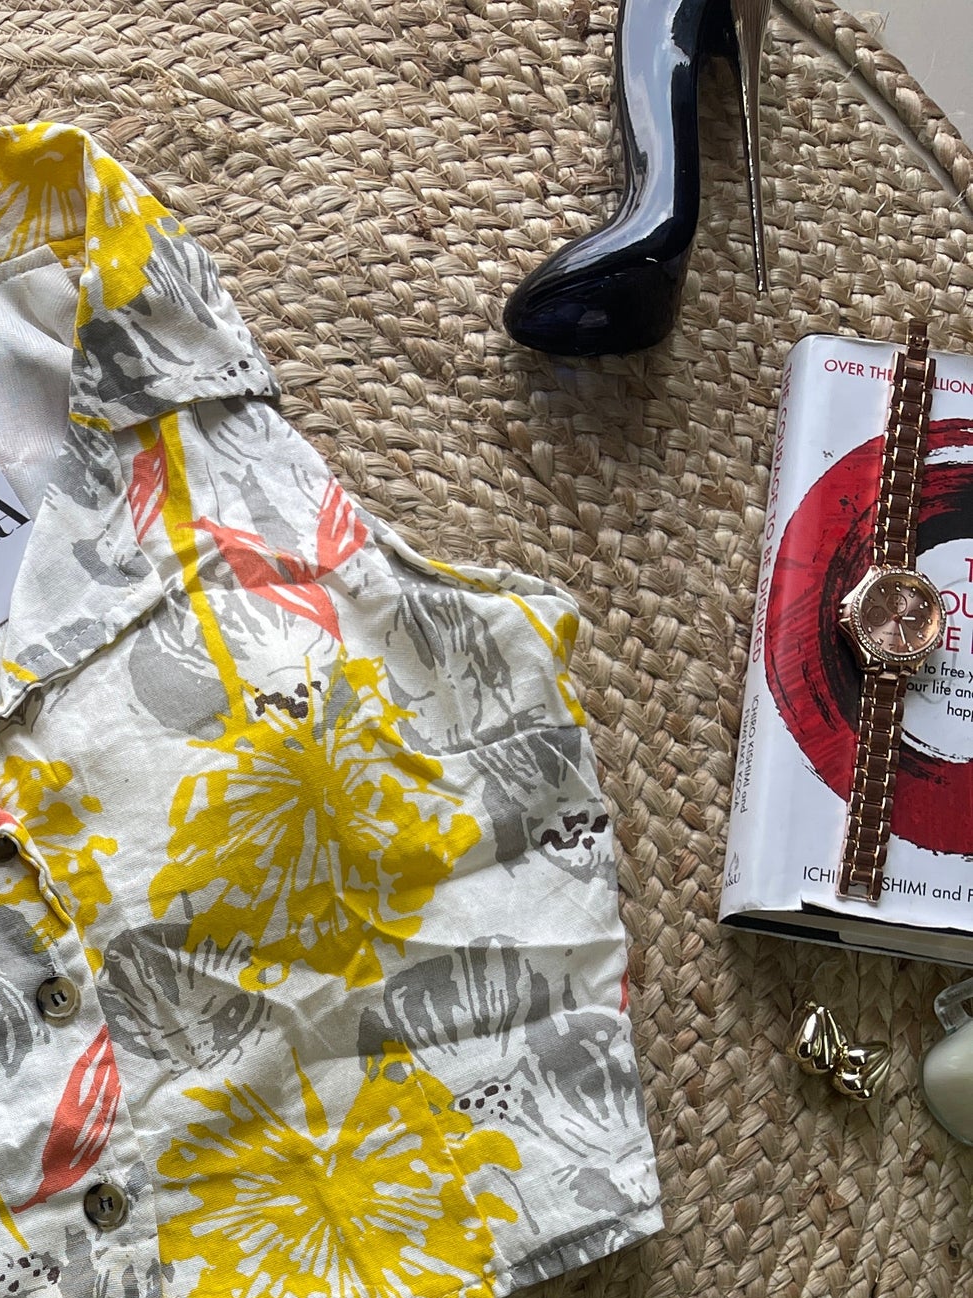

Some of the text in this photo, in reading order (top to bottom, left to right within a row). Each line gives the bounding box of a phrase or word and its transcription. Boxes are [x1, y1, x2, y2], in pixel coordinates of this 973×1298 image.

[824, 359, 864, 377] OVER
[752, 362, 792, 664] THE COURAGE TO BE DISLIKED
[941, 661, 965, 678] free
[932, 680, 951, 696] life
[955, 688, 973, 699] an
[740, 791, 748, 813] and
[803, 866, 835, 884] ICHI
[881, 876, 927, 896] SHIMI
[932, 885, 962, 901] and
